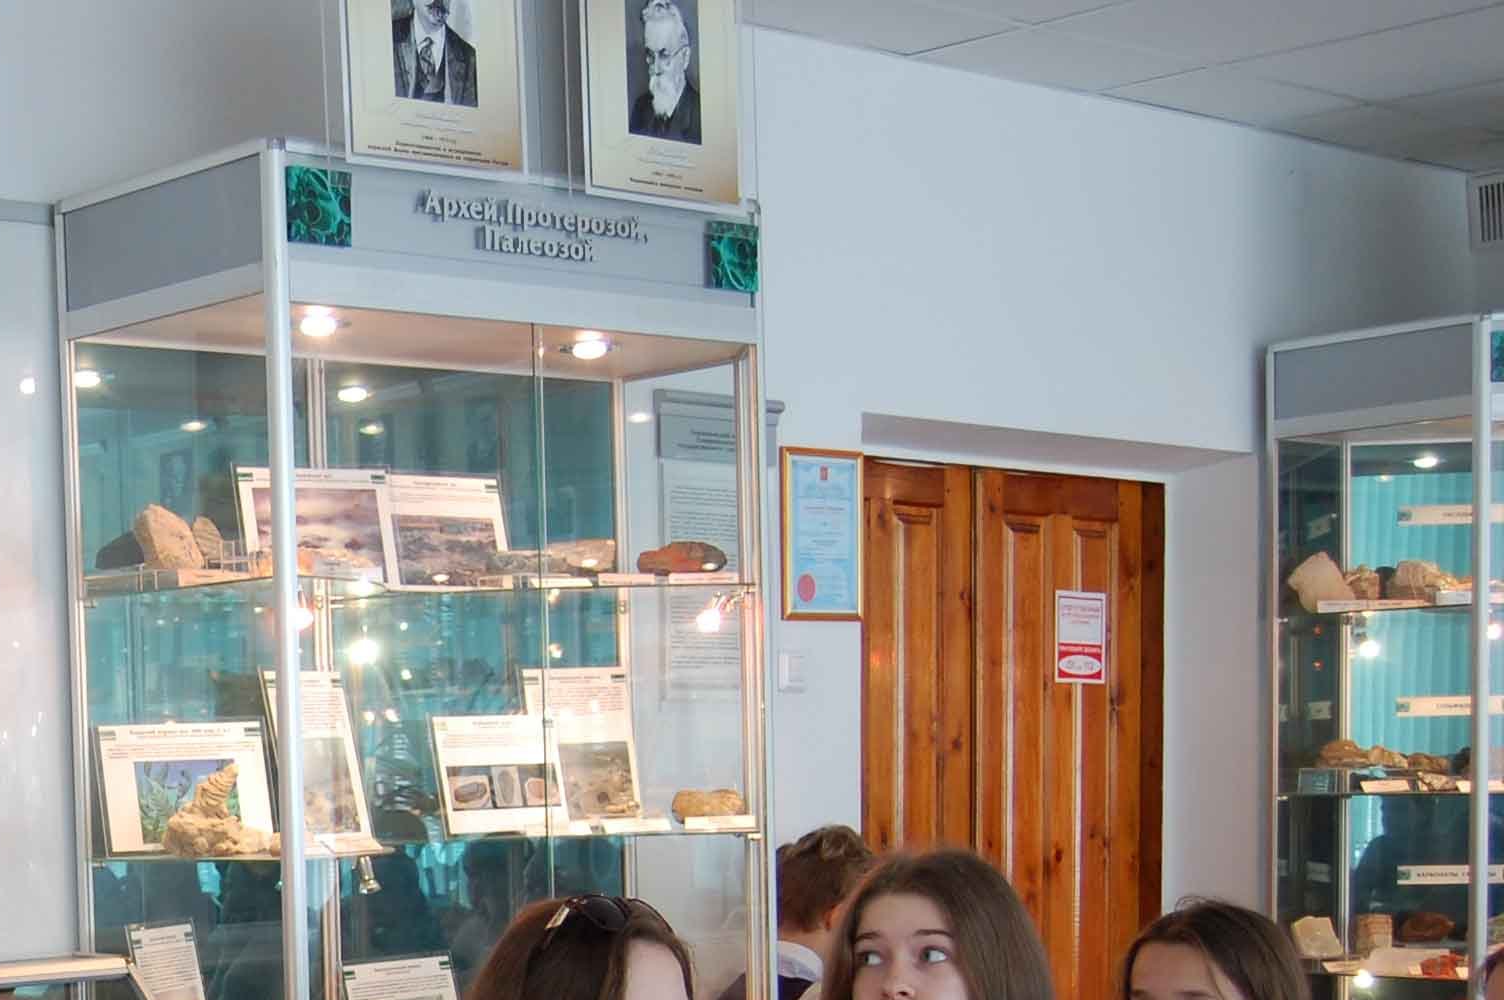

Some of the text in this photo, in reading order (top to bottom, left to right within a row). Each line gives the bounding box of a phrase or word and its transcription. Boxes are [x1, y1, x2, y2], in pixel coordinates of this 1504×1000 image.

[424, 191, 649, 245] Архей, Протерозой,
[484, 224, 593, 262] Палеозой
